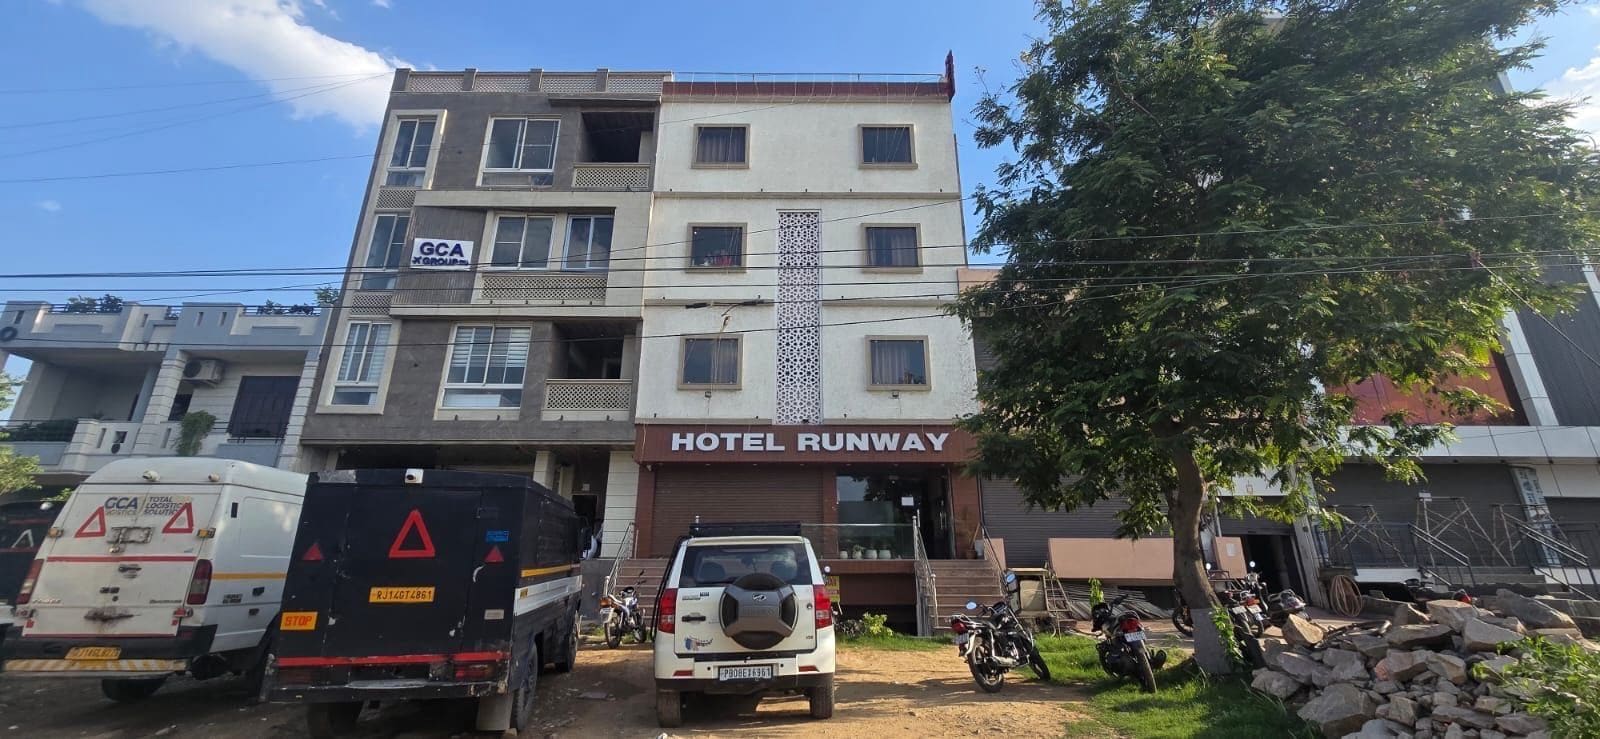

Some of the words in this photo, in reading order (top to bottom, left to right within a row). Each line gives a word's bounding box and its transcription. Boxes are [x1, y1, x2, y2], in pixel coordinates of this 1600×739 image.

[420, 242, 464, 257] GCA
[423, 256, 458, 266] GROUP
[671, 433, 785, 452] HOTEL
[798, 433, 949, 452] RUNWAY
[105, 496, 138, 509] GCA
[376, 590, 432, 600] RJ14GT4861
[285, 616, 313, 627] STOP
